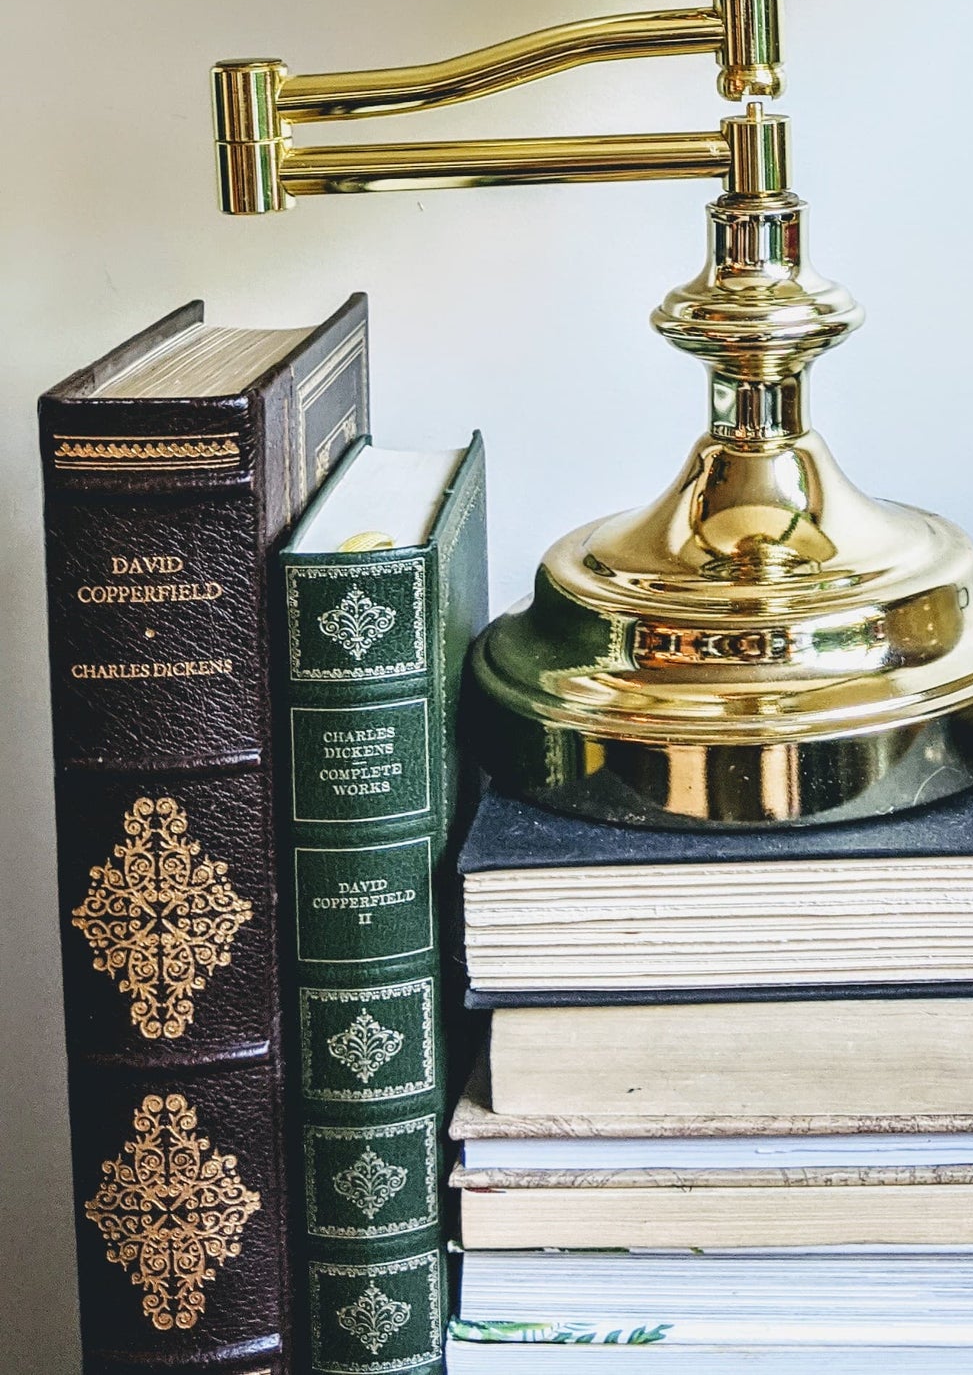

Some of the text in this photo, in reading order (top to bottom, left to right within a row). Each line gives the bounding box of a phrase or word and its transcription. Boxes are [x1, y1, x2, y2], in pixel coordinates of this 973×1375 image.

[111, 555, 184, 575] DAVID
[77, 582, 223, 604] COPPERFIELD
[71, 658, 233, 679] CHARLES DICKENS
[323, 726, 395, 743] CHARLES
[324, 743, 394, 759] DICKENS
[319, 763, 402, 781] COMPLETE
[333, 781, 391, 796] WORKS
[338, 879, 388, 894] DAVID
[312, 889, 416, 909] COPPERFIELD
[358, 913, 372, 925] II
